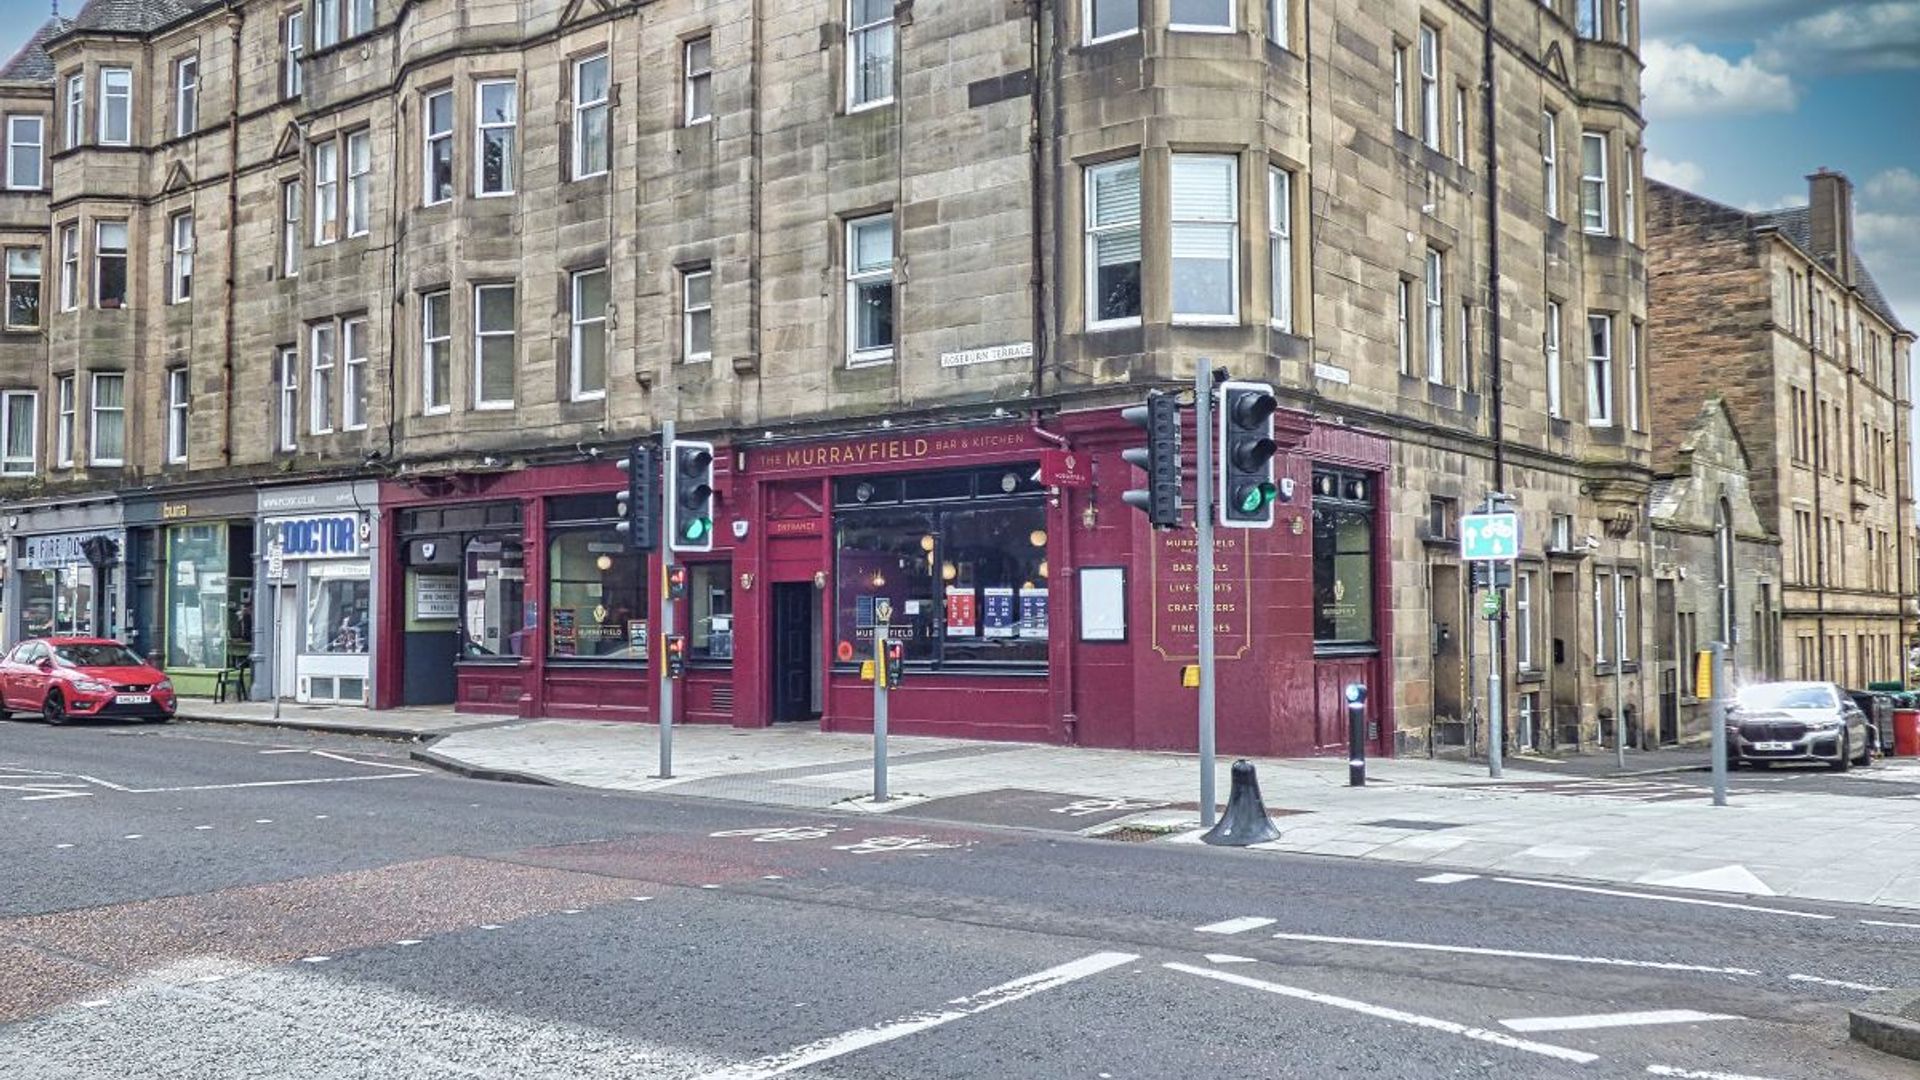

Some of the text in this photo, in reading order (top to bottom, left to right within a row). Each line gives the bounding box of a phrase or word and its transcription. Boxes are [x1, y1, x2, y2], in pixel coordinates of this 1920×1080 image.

[943, 344, 1033, 366] ROSEBURN TERRACE
[761, 434, 1025, 467] THE MURRAYFIELD BAR & KITCHEN
[1173, 563, 1193, 572] BAR
[1169, 583, 1192, 593] LIVE
[1171, 623, 1196, 633] FINE
